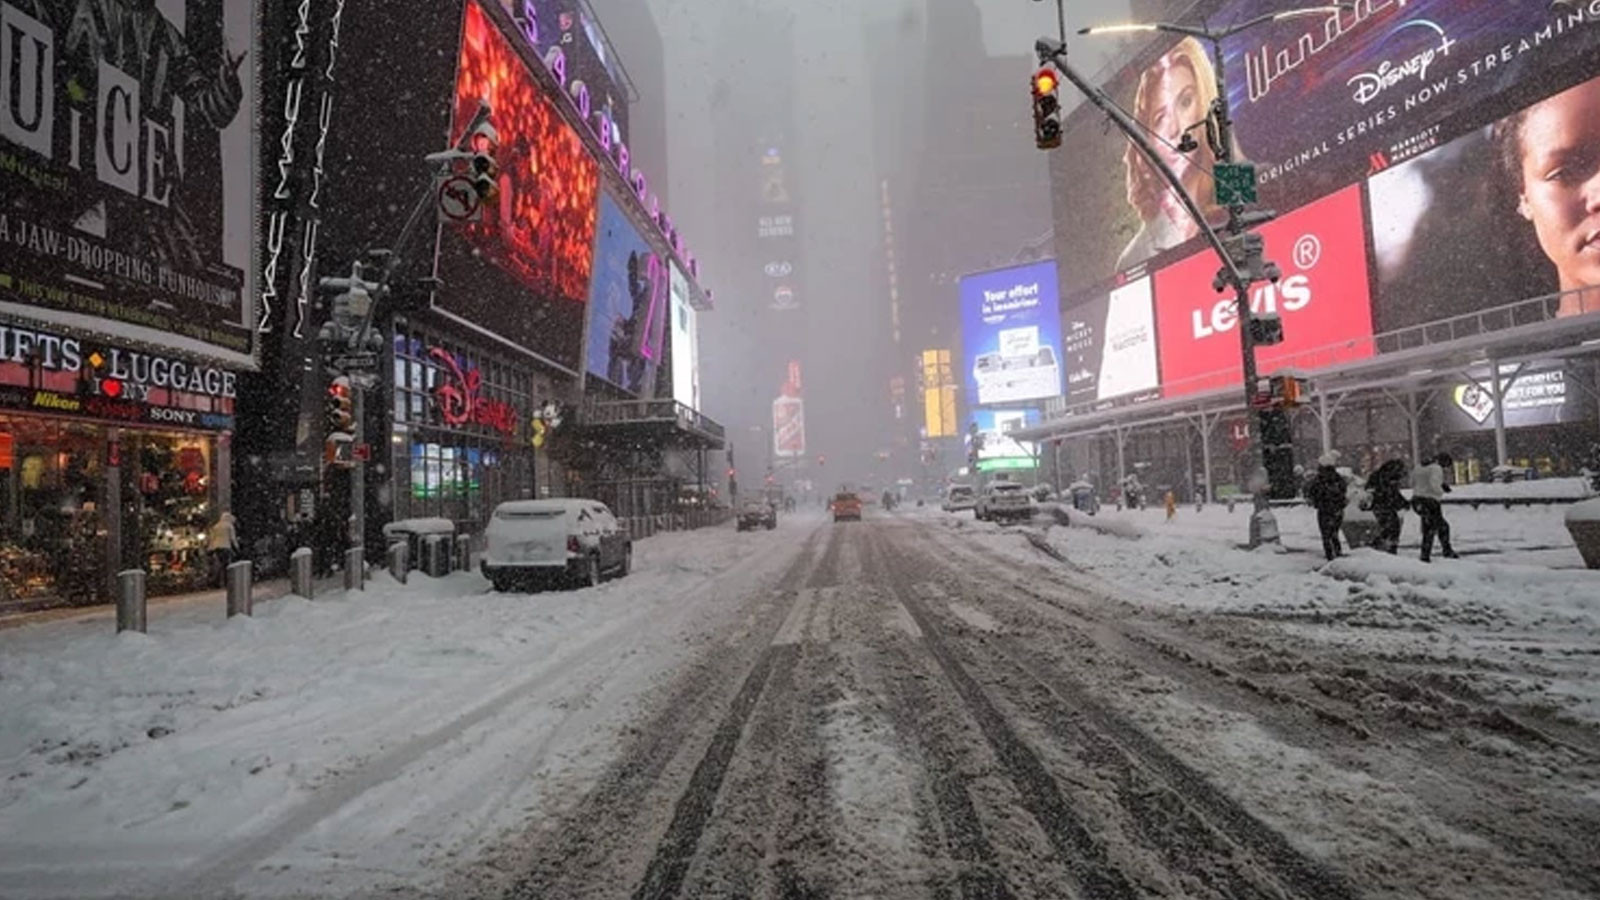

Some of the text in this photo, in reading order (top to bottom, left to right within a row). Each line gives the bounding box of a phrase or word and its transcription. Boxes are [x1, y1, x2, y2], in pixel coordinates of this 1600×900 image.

[1244, 0, 1406, 103] Wanda
[1259, 141, 1331, 185] ORIGINAL
[1337, 105, 1397, 145] SERIES
[1404, 78, 1450, 112] NOW
[0, 213, 10, 242] A
[15, 220, 152, 284] JAW-DROPPING
[33, 391, 80, 411] Nikon
[150, 406, 197, 425] SONY
[109, 349, 237, 398] LUGGAGE
